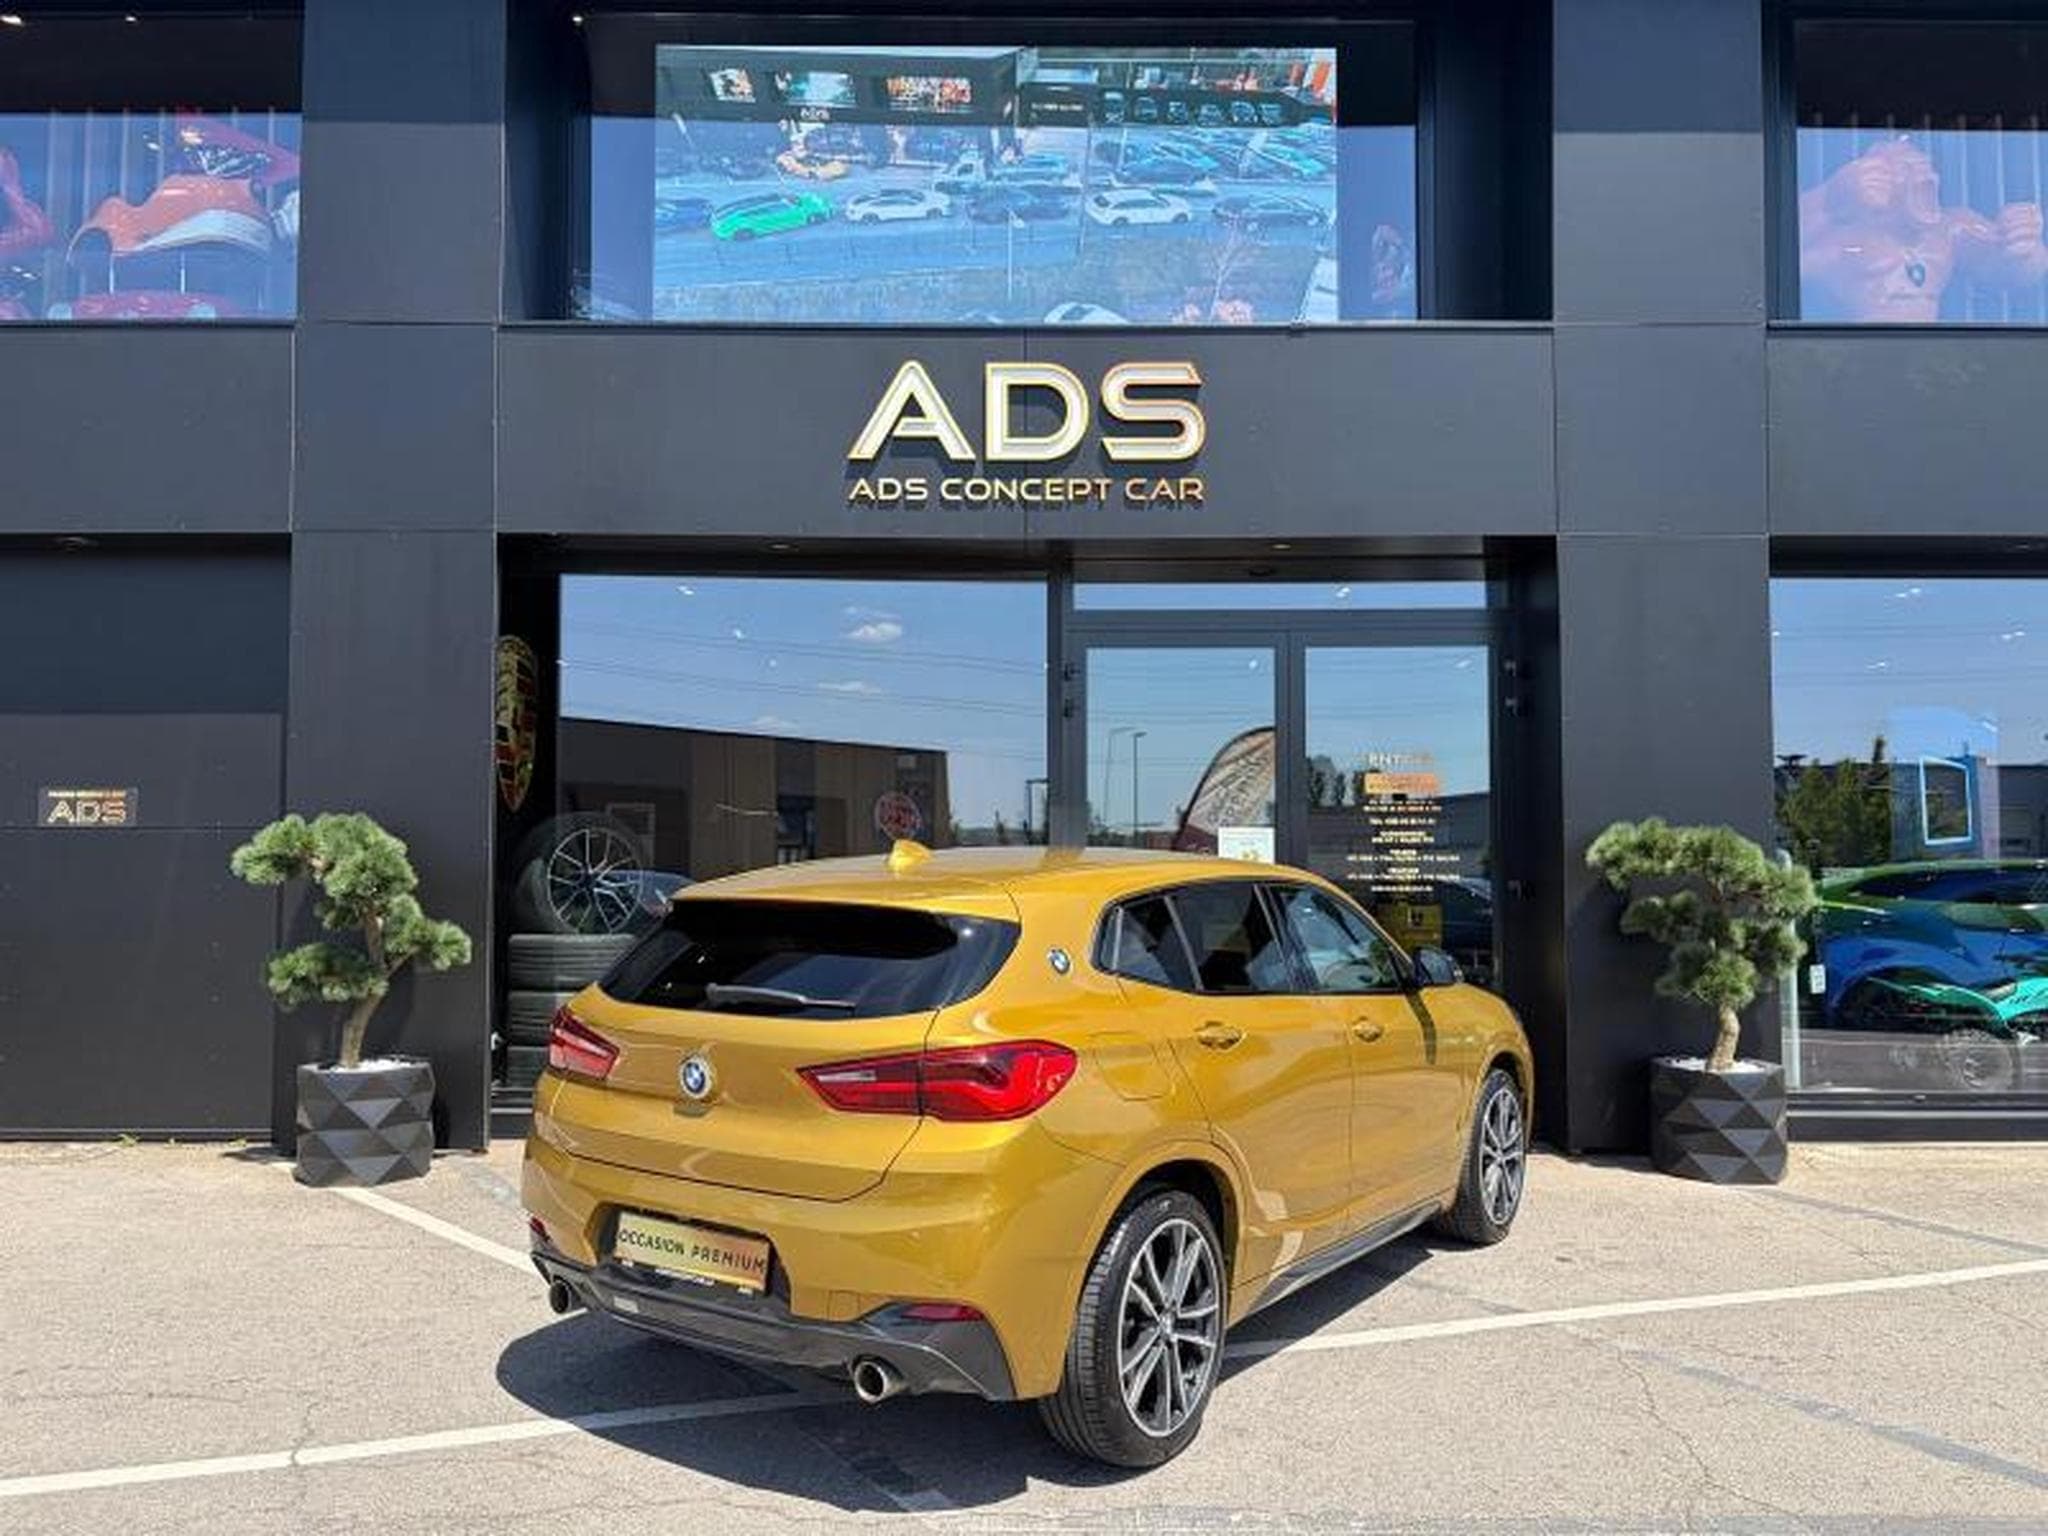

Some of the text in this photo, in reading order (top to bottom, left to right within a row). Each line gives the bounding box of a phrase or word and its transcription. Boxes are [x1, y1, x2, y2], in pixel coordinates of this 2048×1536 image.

[847, 360, 1206, 461] ADS
[849, 478, 1204, 500] ADS CONCEPT CAR
[47, 800, 126, 823] ADS
[618, 1229, 765, 1273] OCCASION PREMIUM
